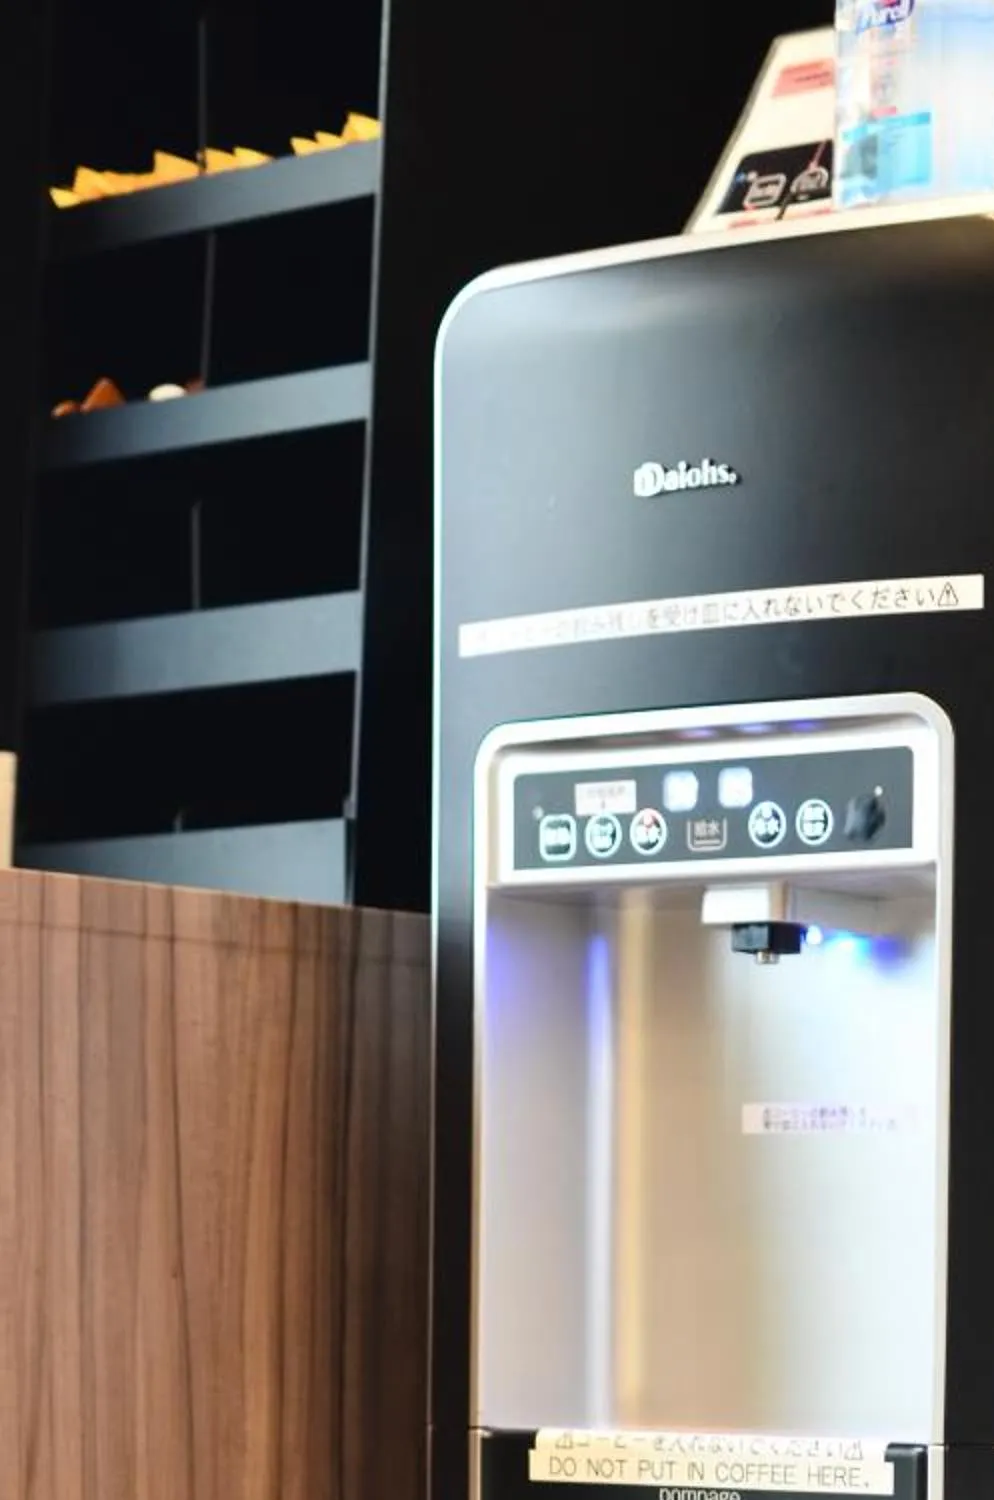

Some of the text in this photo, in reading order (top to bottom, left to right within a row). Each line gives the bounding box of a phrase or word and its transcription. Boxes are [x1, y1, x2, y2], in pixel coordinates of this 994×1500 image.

[549, 1456, 870, 1489] DO NOT PUT IN COFFEE HERE.
